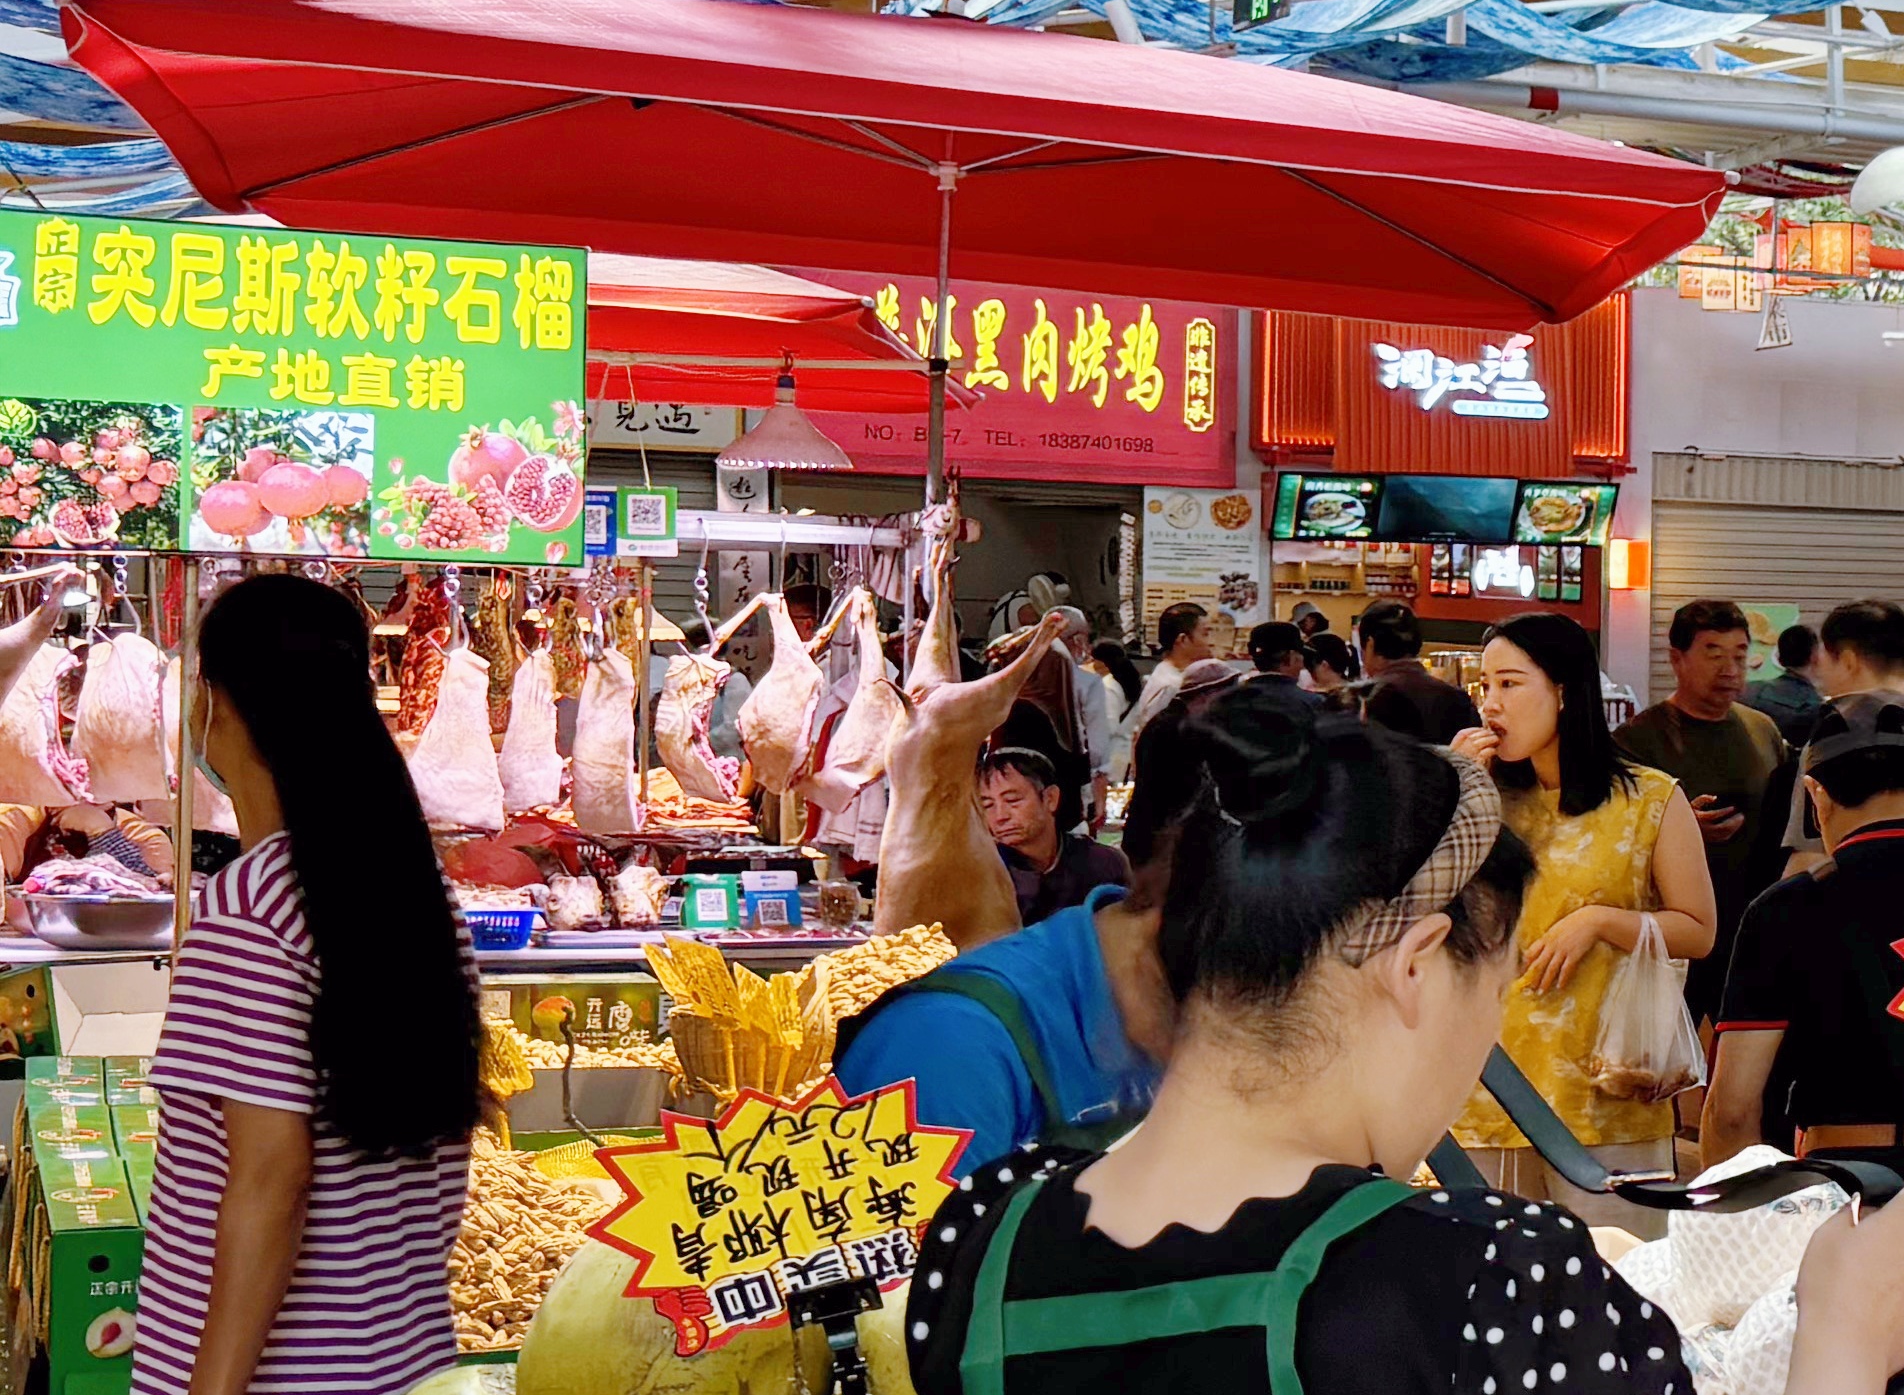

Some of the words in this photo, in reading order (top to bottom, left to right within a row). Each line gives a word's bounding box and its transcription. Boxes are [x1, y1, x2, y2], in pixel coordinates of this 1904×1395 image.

[37, 219, 78, 312] 正宗
[87, 225, 573, 350] 突尼斯软籽石榴
[202, 343, 465, 411] 产地直销
[1189, 325, 1211, 421] 非遗传承
[914, 426, 962, 444] B-7
[1038, 433, 1154, 453] 18387401698
[686, 1131, 921, 1221] 现开现喝
[672, 1175, 919, 1282] 海南椰青
